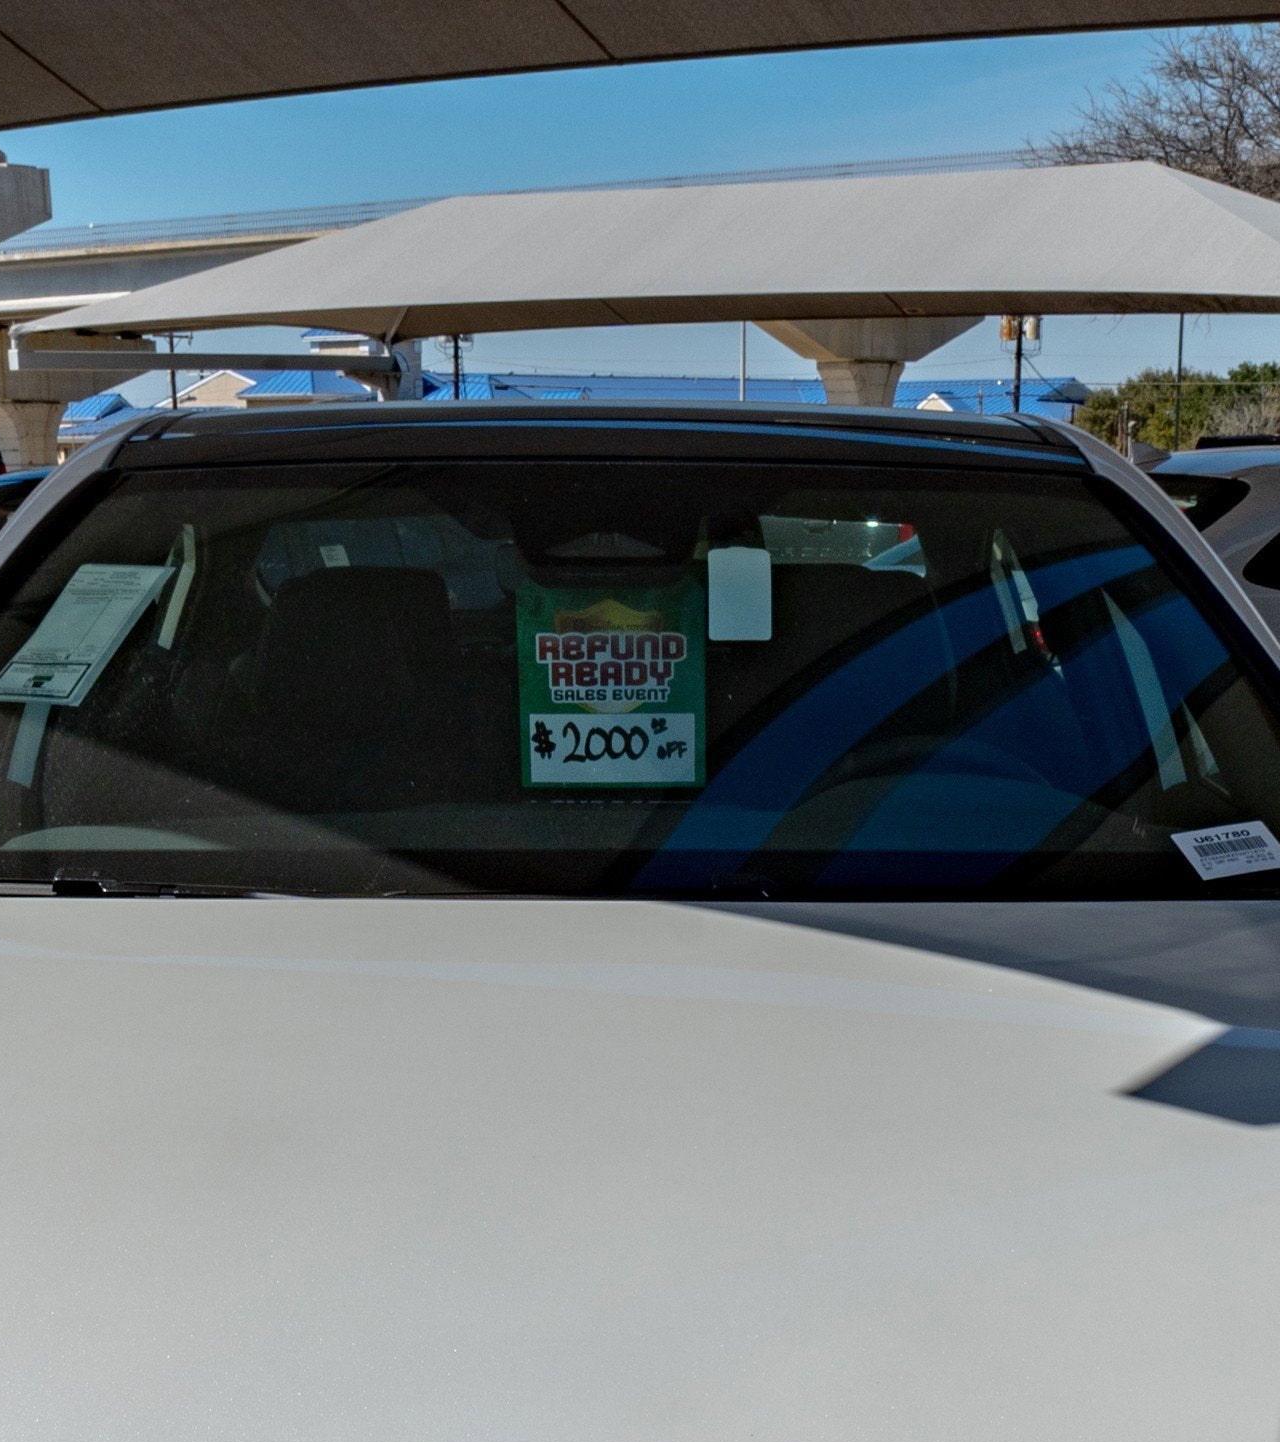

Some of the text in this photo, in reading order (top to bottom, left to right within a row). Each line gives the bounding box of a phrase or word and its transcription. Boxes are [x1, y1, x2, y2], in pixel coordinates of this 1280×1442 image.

[537, 633, 686, 661] REFUND
[550, 660, 673, 687] READY
[553, 688, 669, 701] SALES EVENT
[1193, 829, 1251, 844] U61780
